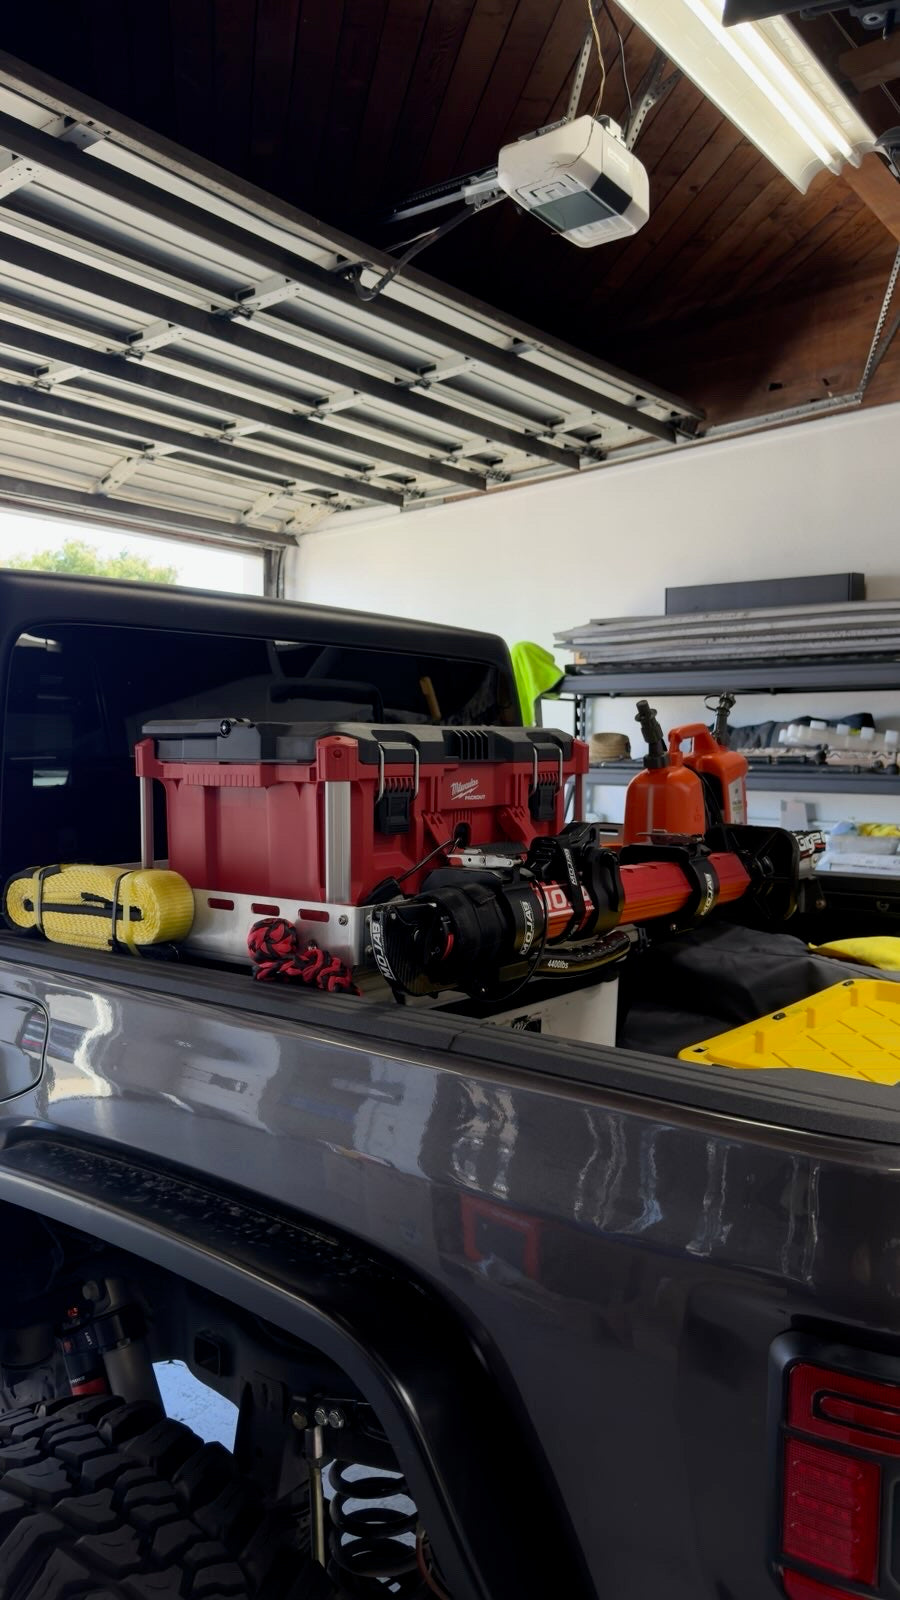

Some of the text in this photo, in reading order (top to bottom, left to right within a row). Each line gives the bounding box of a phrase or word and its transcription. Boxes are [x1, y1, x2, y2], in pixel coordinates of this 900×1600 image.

[372, 922, 395, 980] MOJAB
[520, 900, 535, 956] MOJAB
[547, 959, 569, 969] 4400lbs
